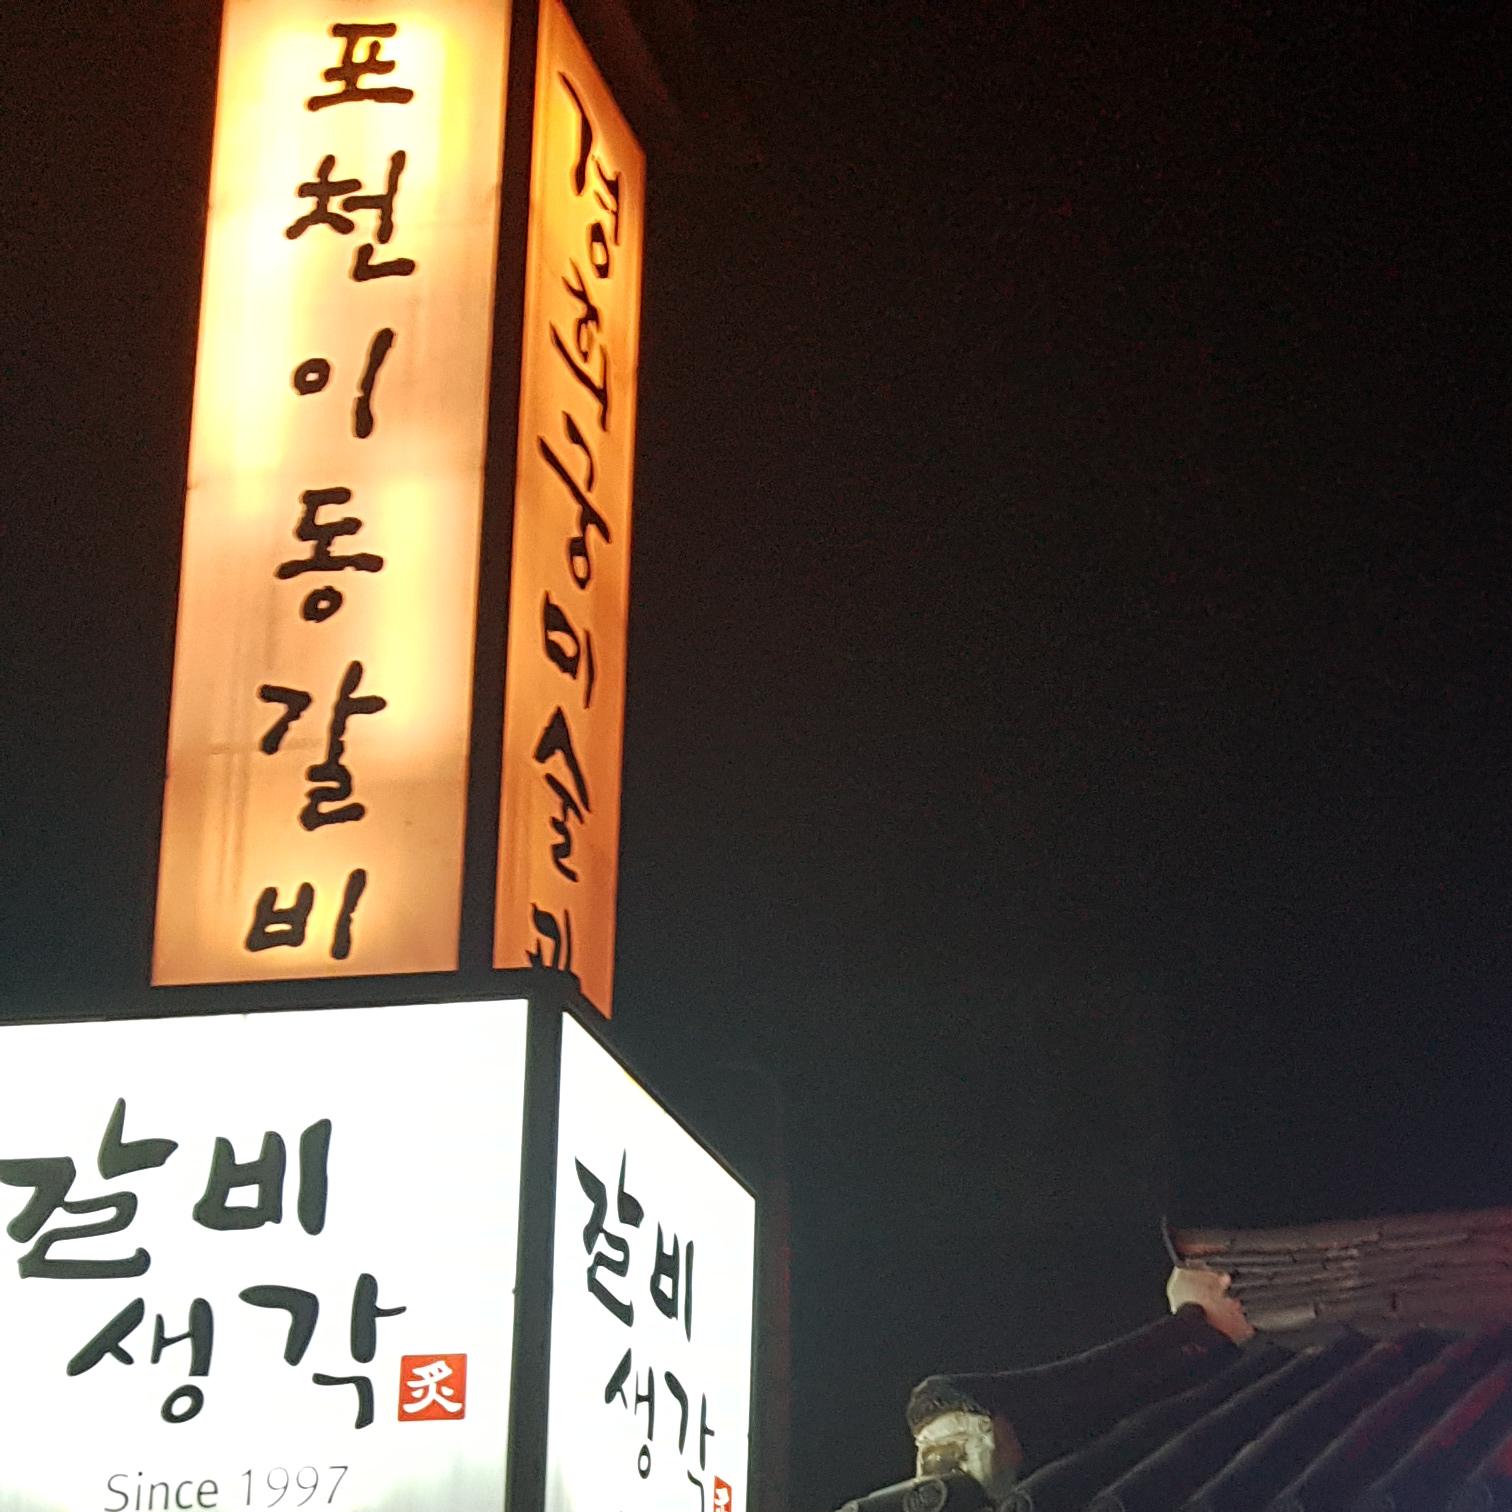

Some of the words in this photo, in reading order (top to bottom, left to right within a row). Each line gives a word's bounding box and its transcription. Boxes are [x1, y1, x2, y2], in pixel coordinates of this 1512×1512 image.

[246, 23, 414, 959] 포천이동갈비
[0, 1097, 331, 1279] 갈비
[575, 1149, 694, 1342] 갈비
[67, 1273, 406, 1429] 생각
[240, 1465, 349, 1510] 1997
